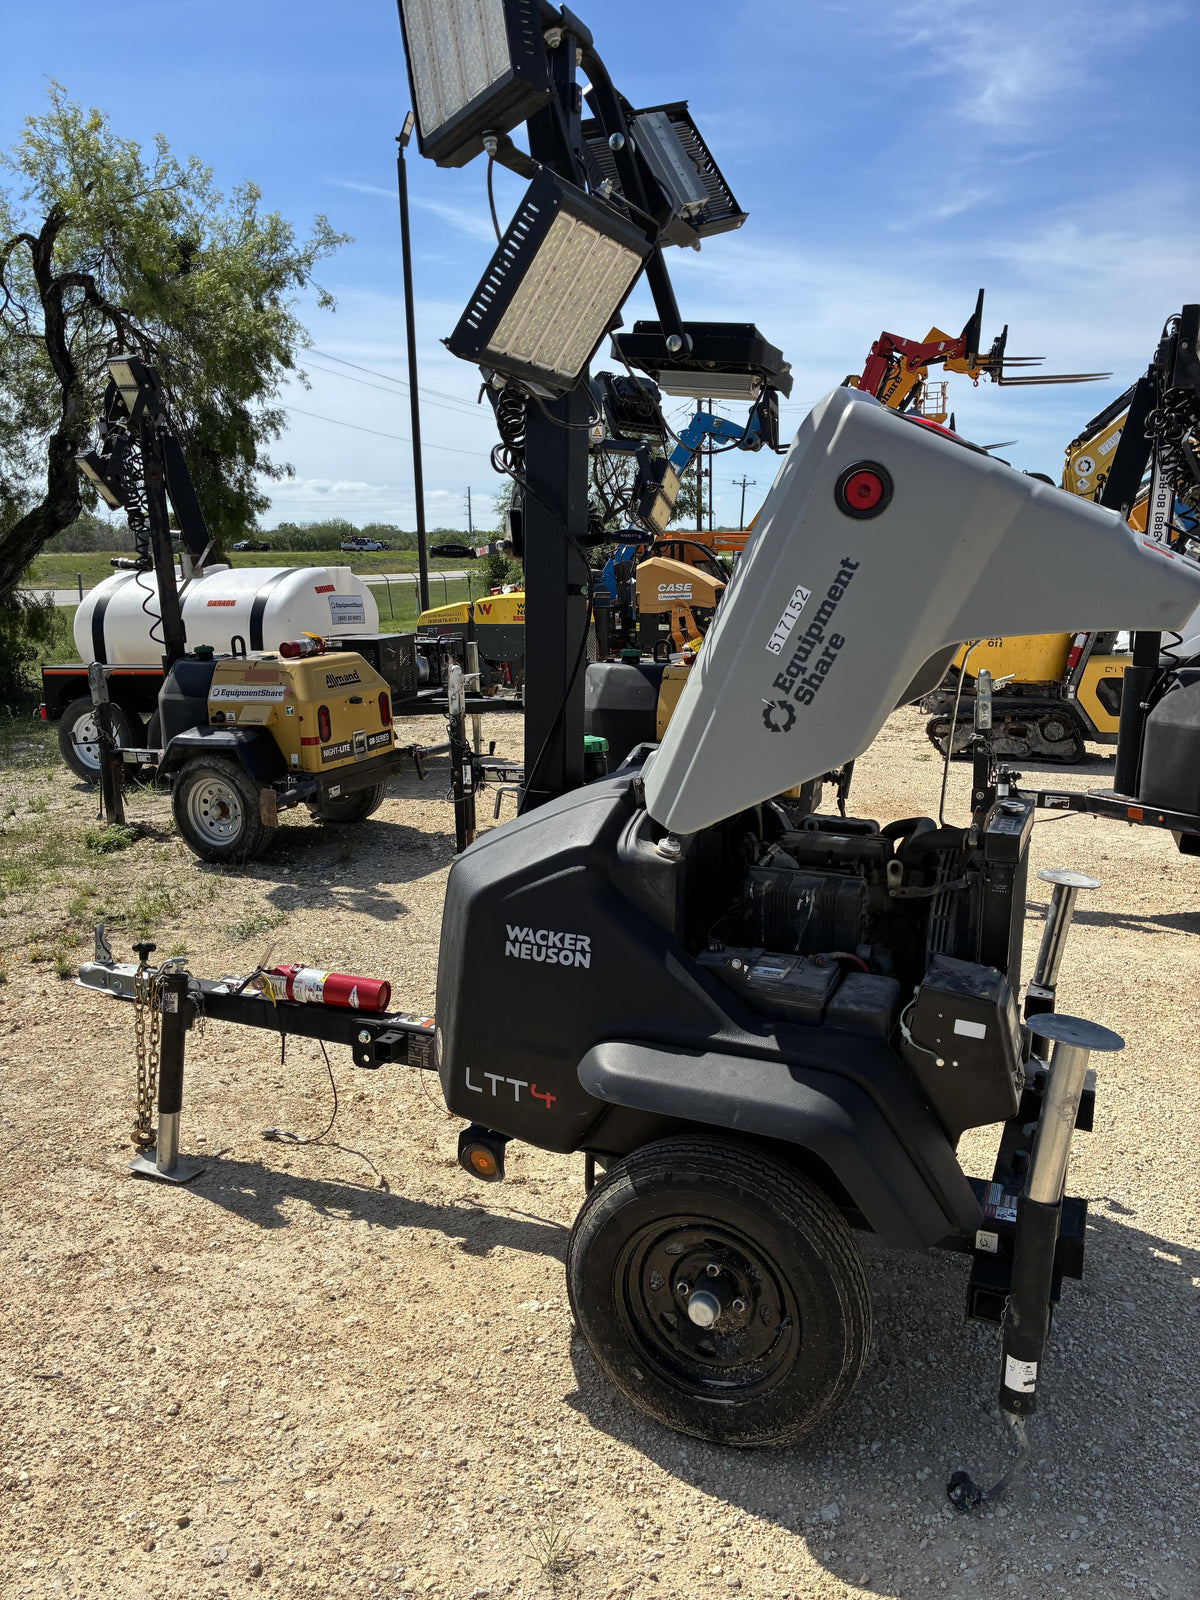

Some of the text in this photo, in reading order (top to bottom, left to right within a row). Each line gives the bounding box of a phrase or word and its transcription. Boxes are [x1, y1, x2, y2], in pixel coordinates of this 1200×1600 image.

[657, 583, 693, 592] CASE
[768, 589, 809, 653] 517152
[772, 556, 860, 695] Equipment
[326, 670, 361, 688] Allmand
[794, 632, 846, 706] Share
[220, 688, 284, 698] EquipmentShare
[505, 924, 592, 952] WACKER
[505, 940, 592, 969] NEUSON
[465, 1066, 557, 1109] LTT4
